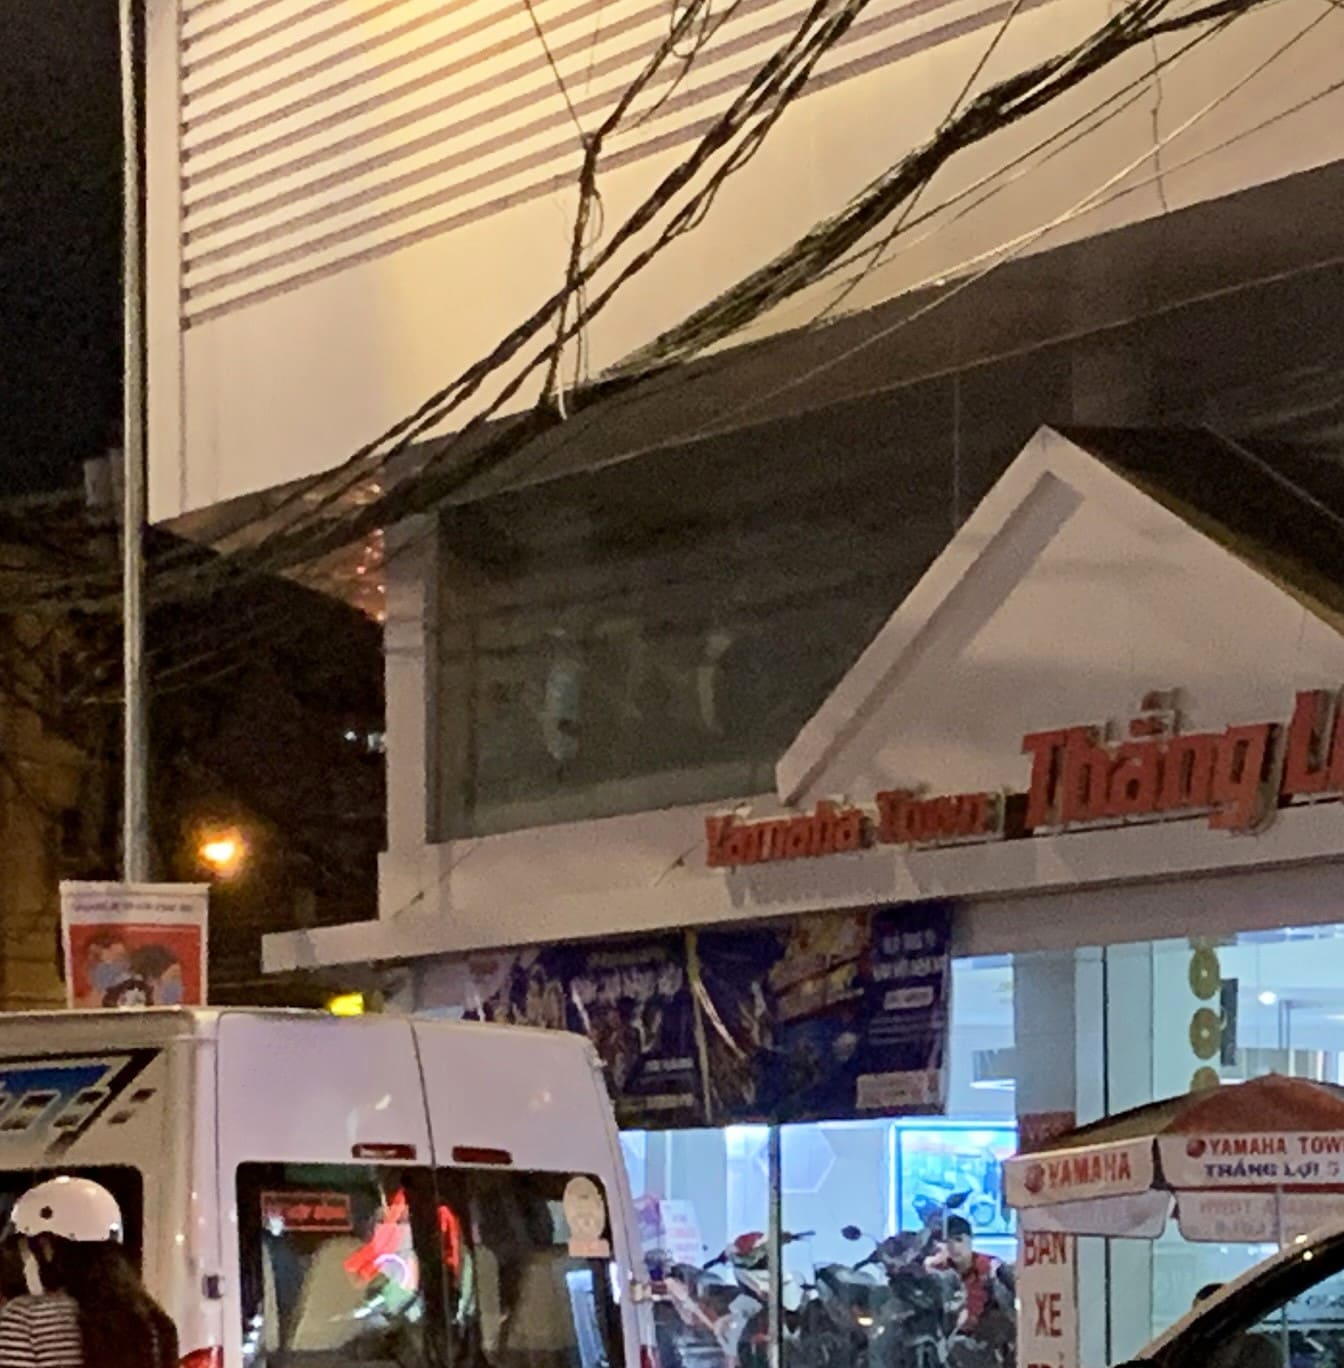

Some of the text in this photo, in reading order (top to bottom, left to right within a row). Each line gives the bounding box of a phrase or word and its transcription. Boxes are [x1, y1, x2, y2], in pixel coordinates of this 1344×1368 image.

[705, 799, 864, 868] Yamaha
[1209, 1136, 1288, 1156] YAMAHA
[1049, 1152, 1132, 1189] YAMAHA
[1035, 1293, 1063, 1338] XE
